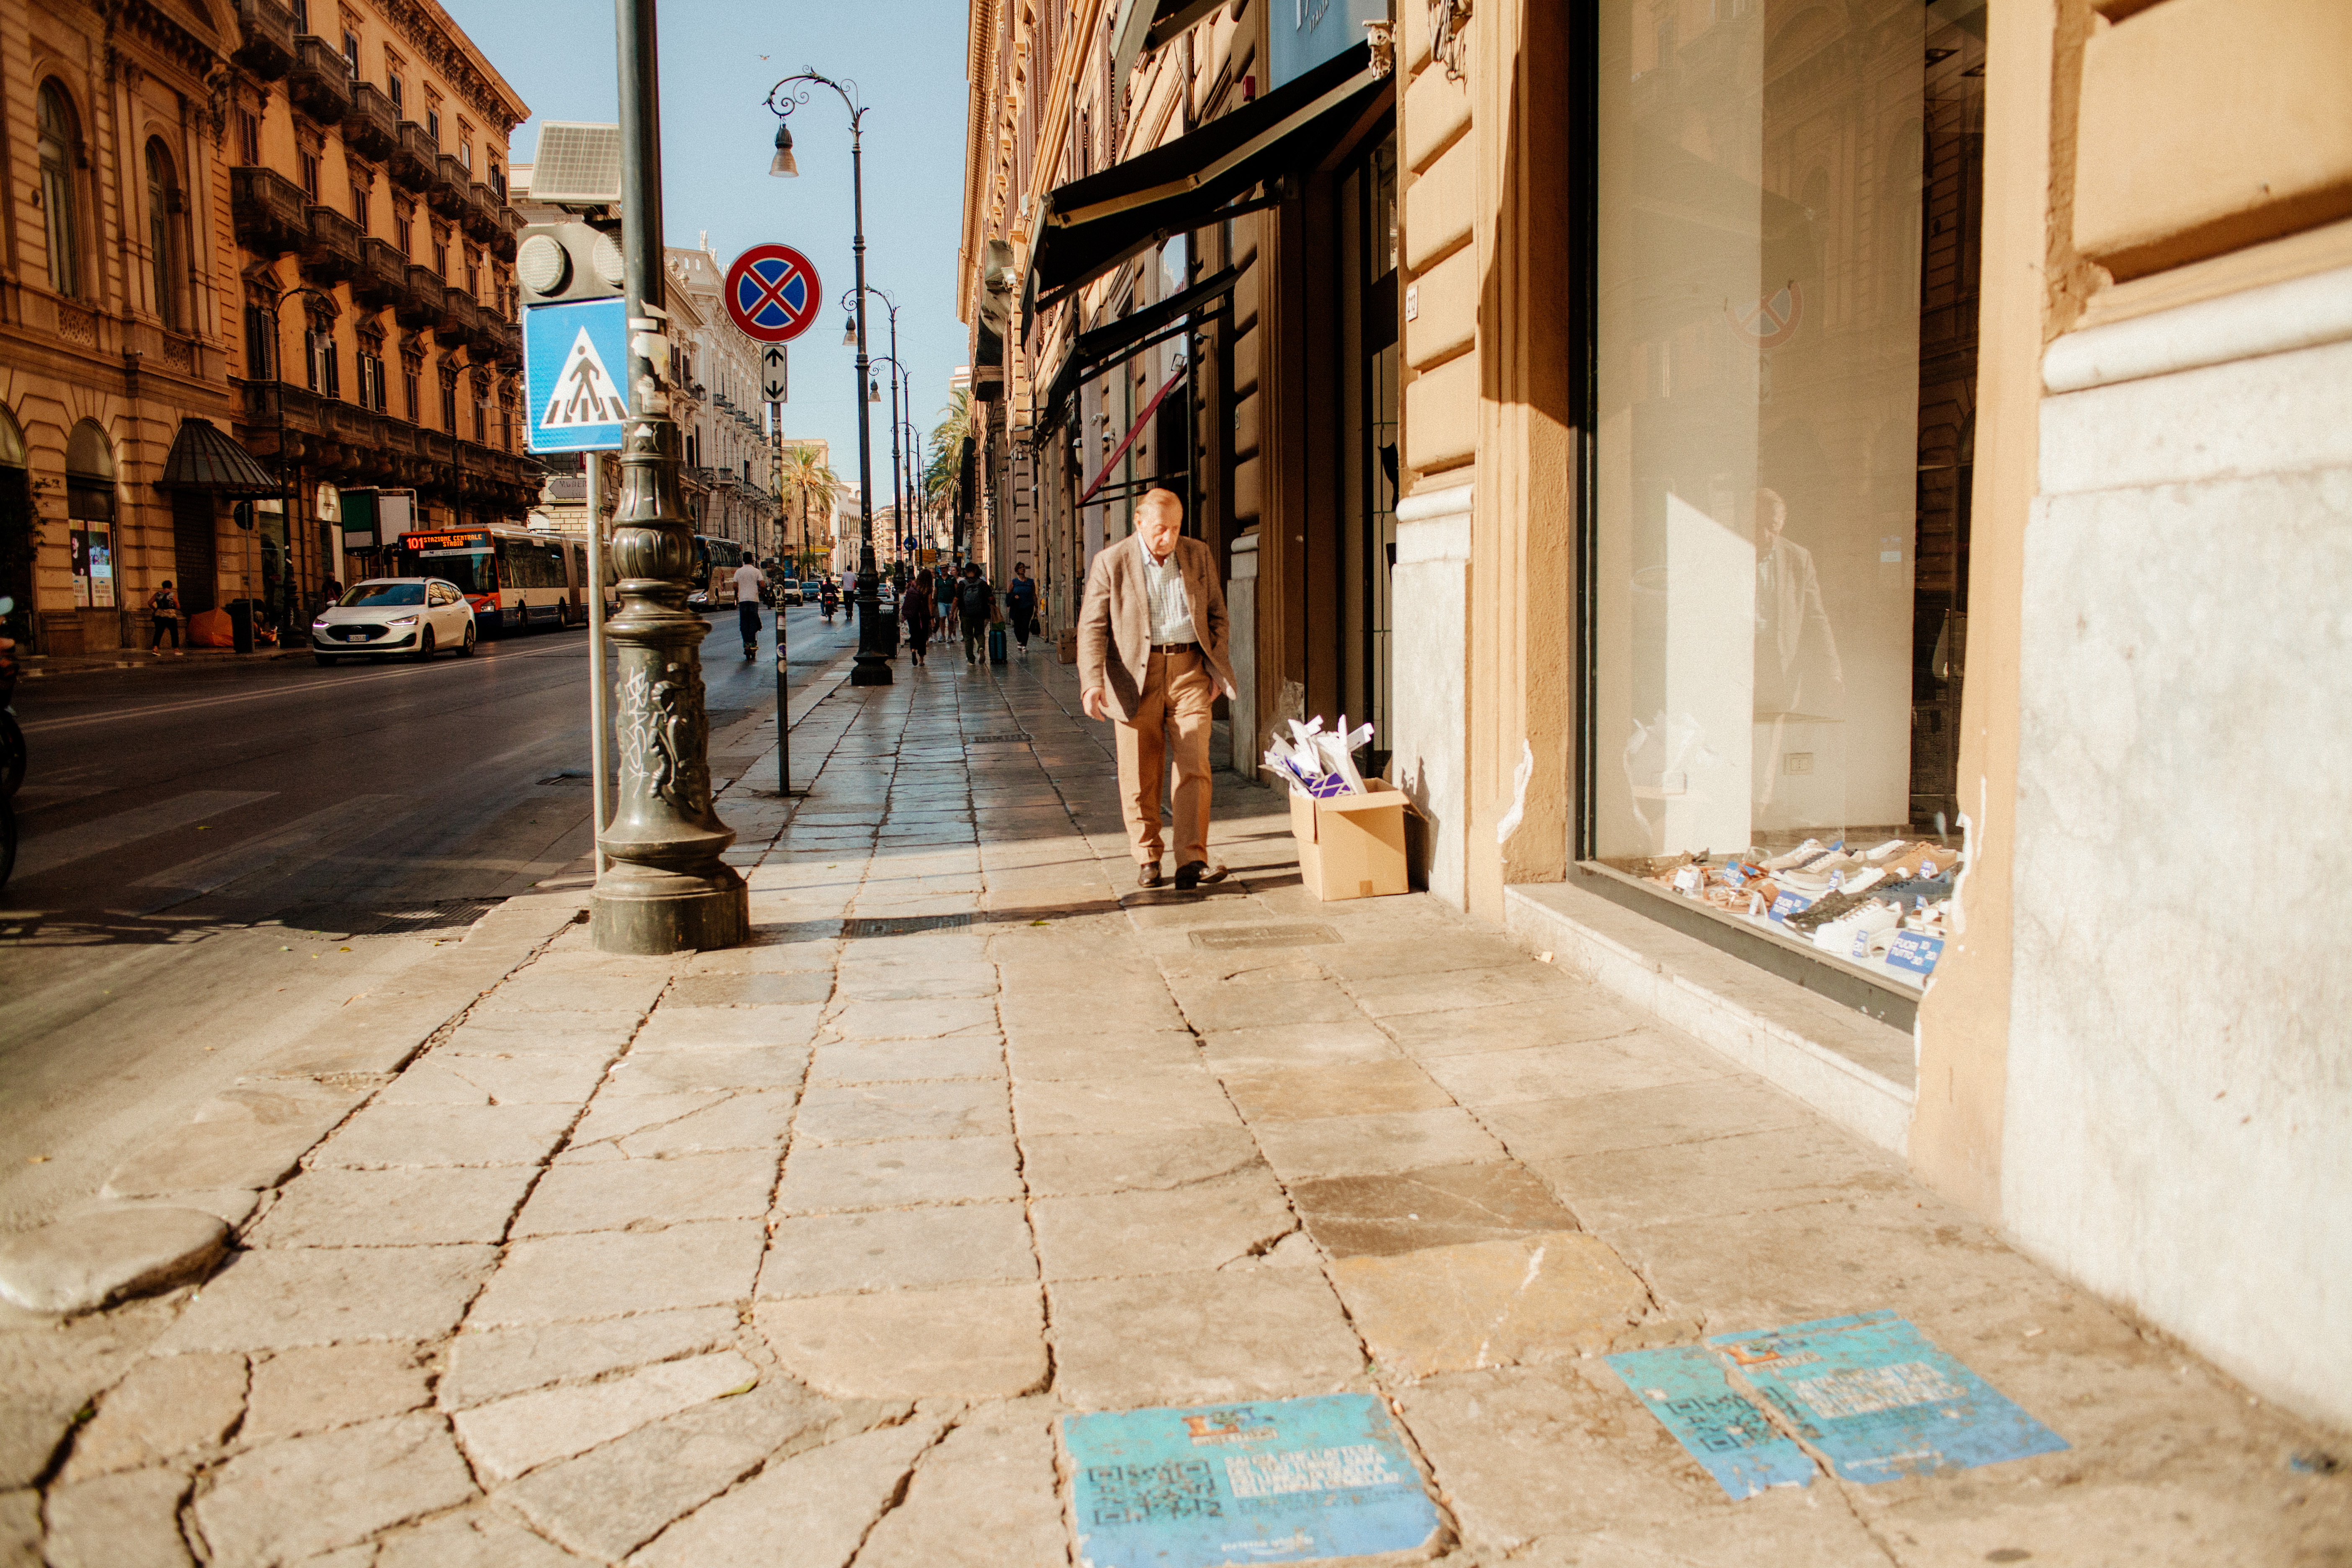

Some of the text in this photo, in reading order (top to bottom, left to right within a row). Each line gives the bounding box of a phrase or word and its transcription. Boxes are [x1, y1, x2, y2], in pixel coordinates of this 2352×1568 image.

[407, 537, 424, 549] 101
[1893, 937, 1919, 952] FUORI
[1890, 946, 1915, 960] TUTTO
